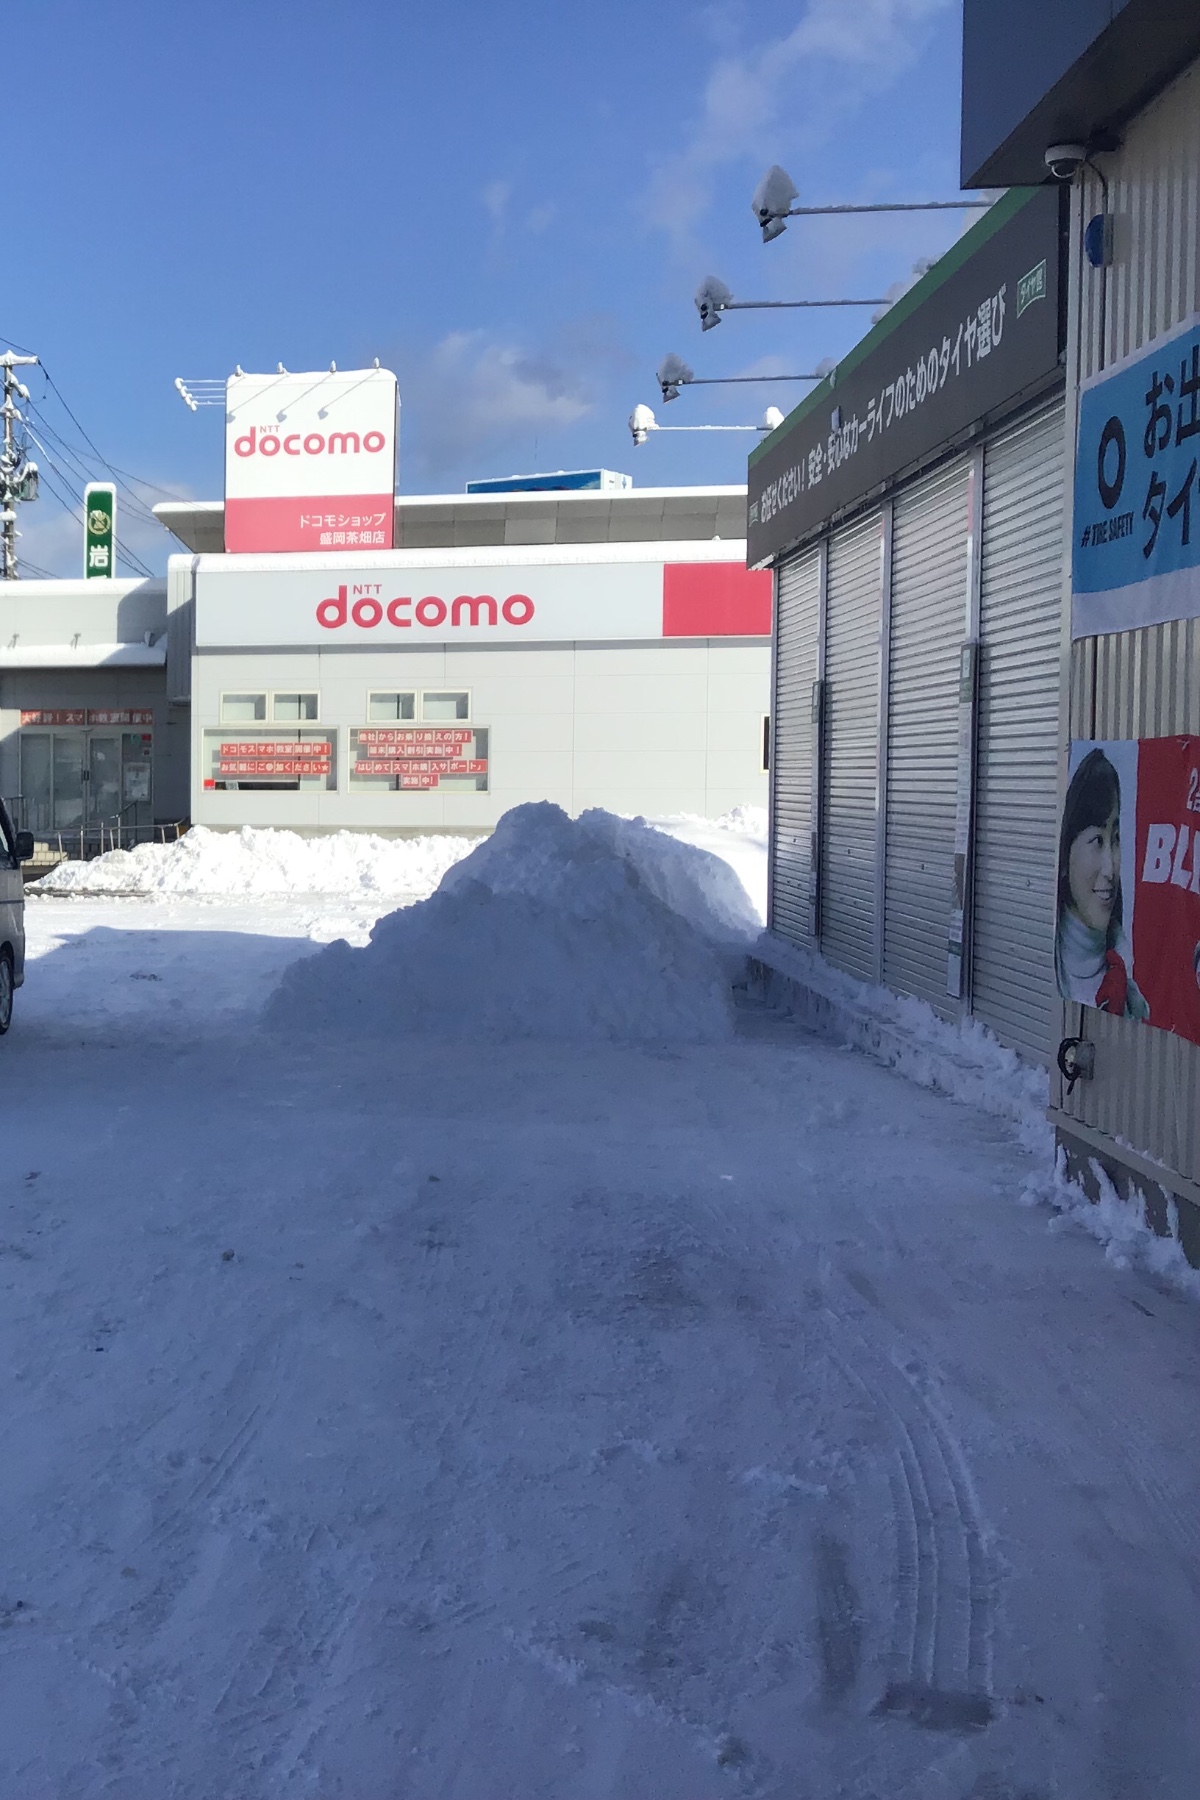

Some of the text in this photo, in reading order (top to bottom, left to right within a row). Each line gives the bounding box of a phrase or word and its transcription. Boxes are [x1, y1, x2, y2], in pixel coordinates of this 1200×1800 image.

[259, 425, 280, 433] NTT
[234, 426, 386, 457] docomo
[1143, 458, 1200, 559] タイ
[300, 512, 387, 529] ドコモショップ
[319, 531, 385, 545] 盛岡茶畑店
[353, 584, 382, 595] NTT
[315, 585, 535, 629] docomo
